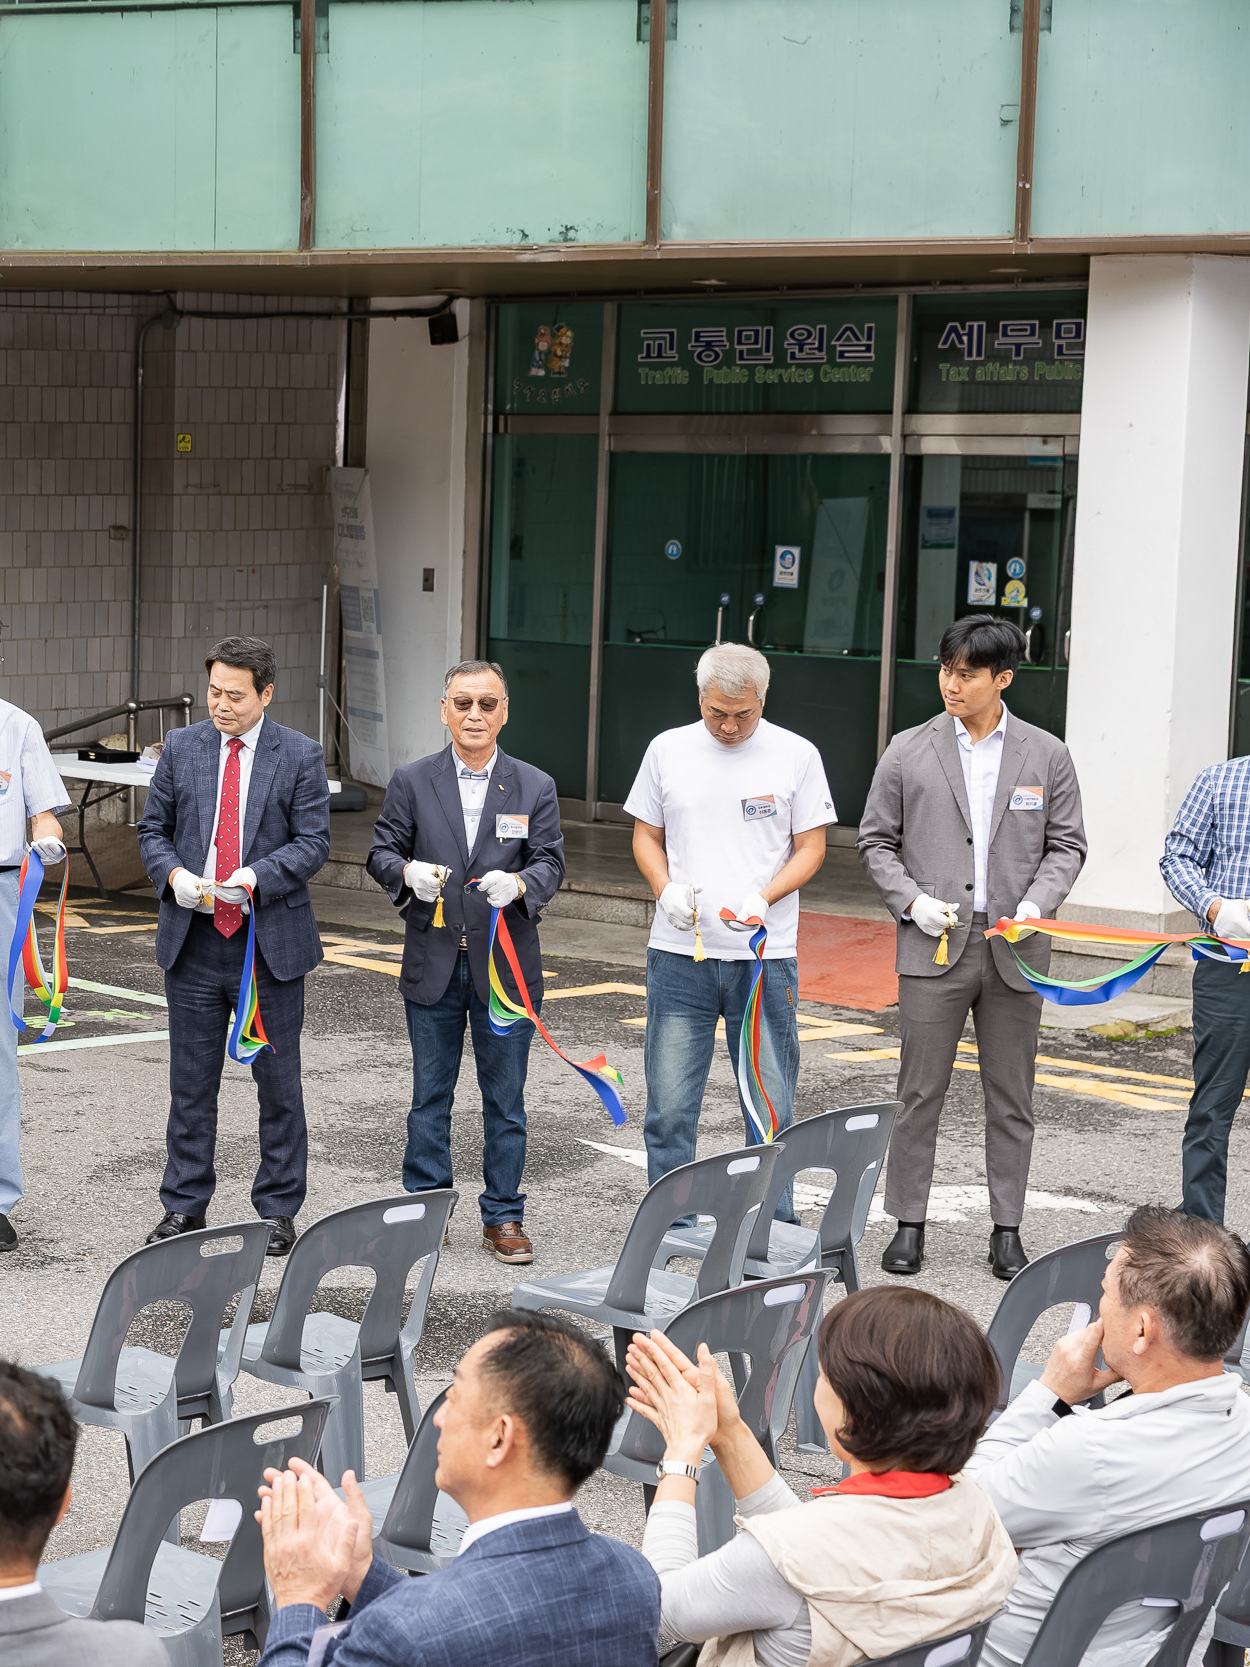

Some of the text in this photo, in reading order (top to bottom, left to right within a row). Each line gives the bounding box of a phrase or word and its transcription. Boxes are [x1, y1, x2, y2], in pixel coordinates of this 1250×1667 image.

[638, 323, 875, 365] 교통민원실
[638, 363, 874, 385] Traffic Public Service Center
[939, 361, 1082, 382] Tax affairs Public
